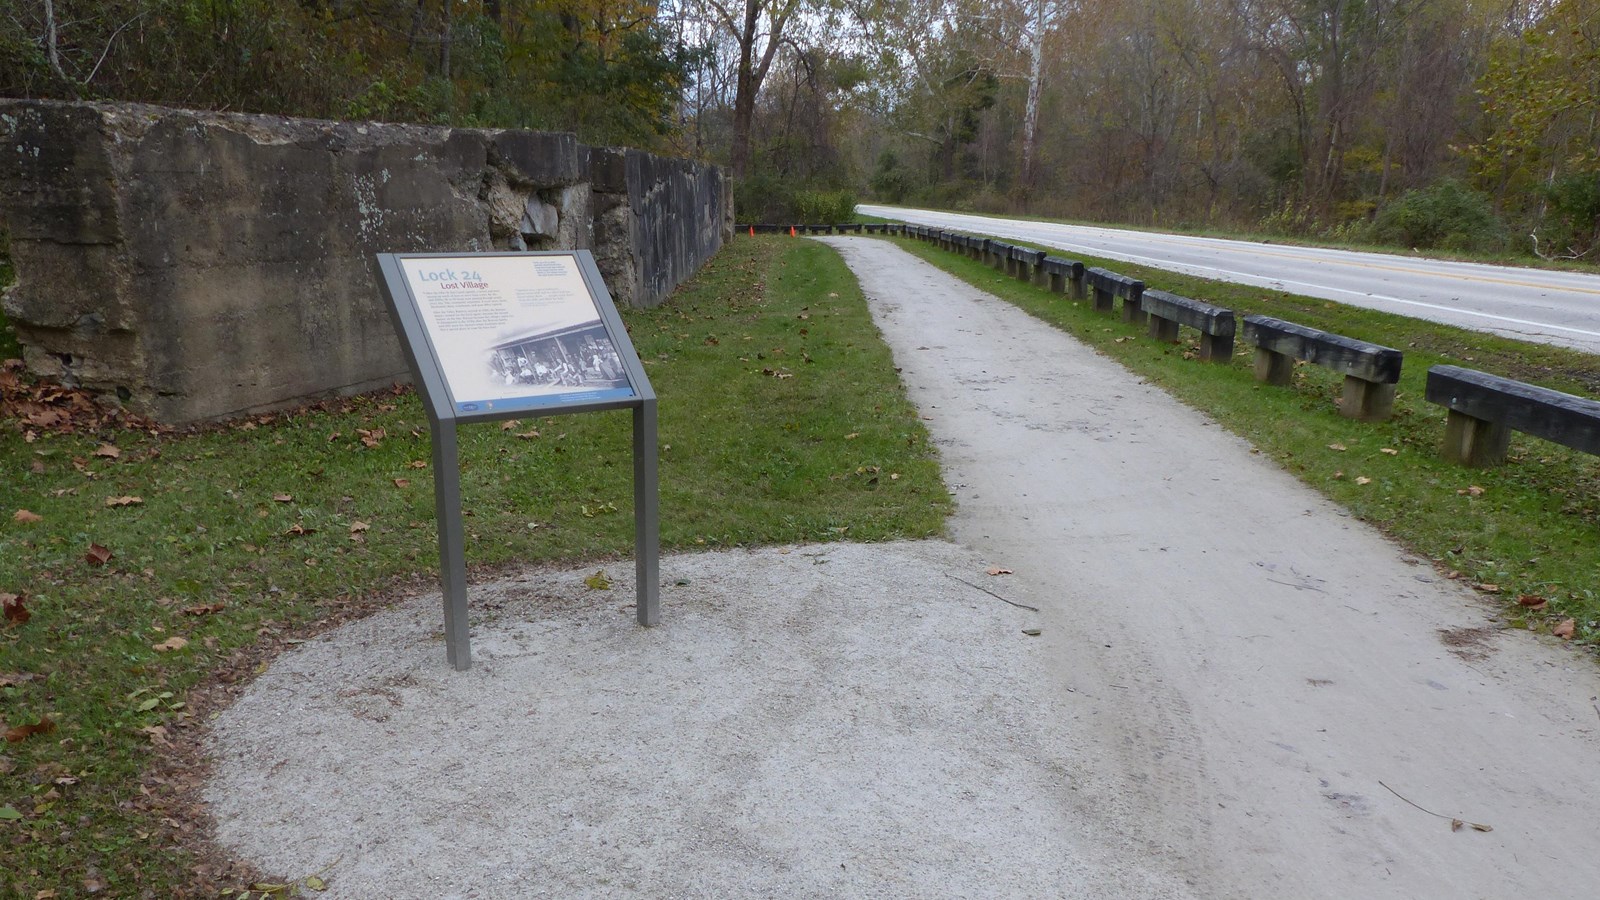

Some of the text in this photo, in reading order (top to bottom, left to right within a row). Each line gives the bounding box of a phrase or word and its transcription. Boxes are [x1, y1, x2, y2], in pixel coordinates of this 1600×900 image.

[418, 268, 482, 282] Lock 24
[440, 281, 489, 290] Lost Village
